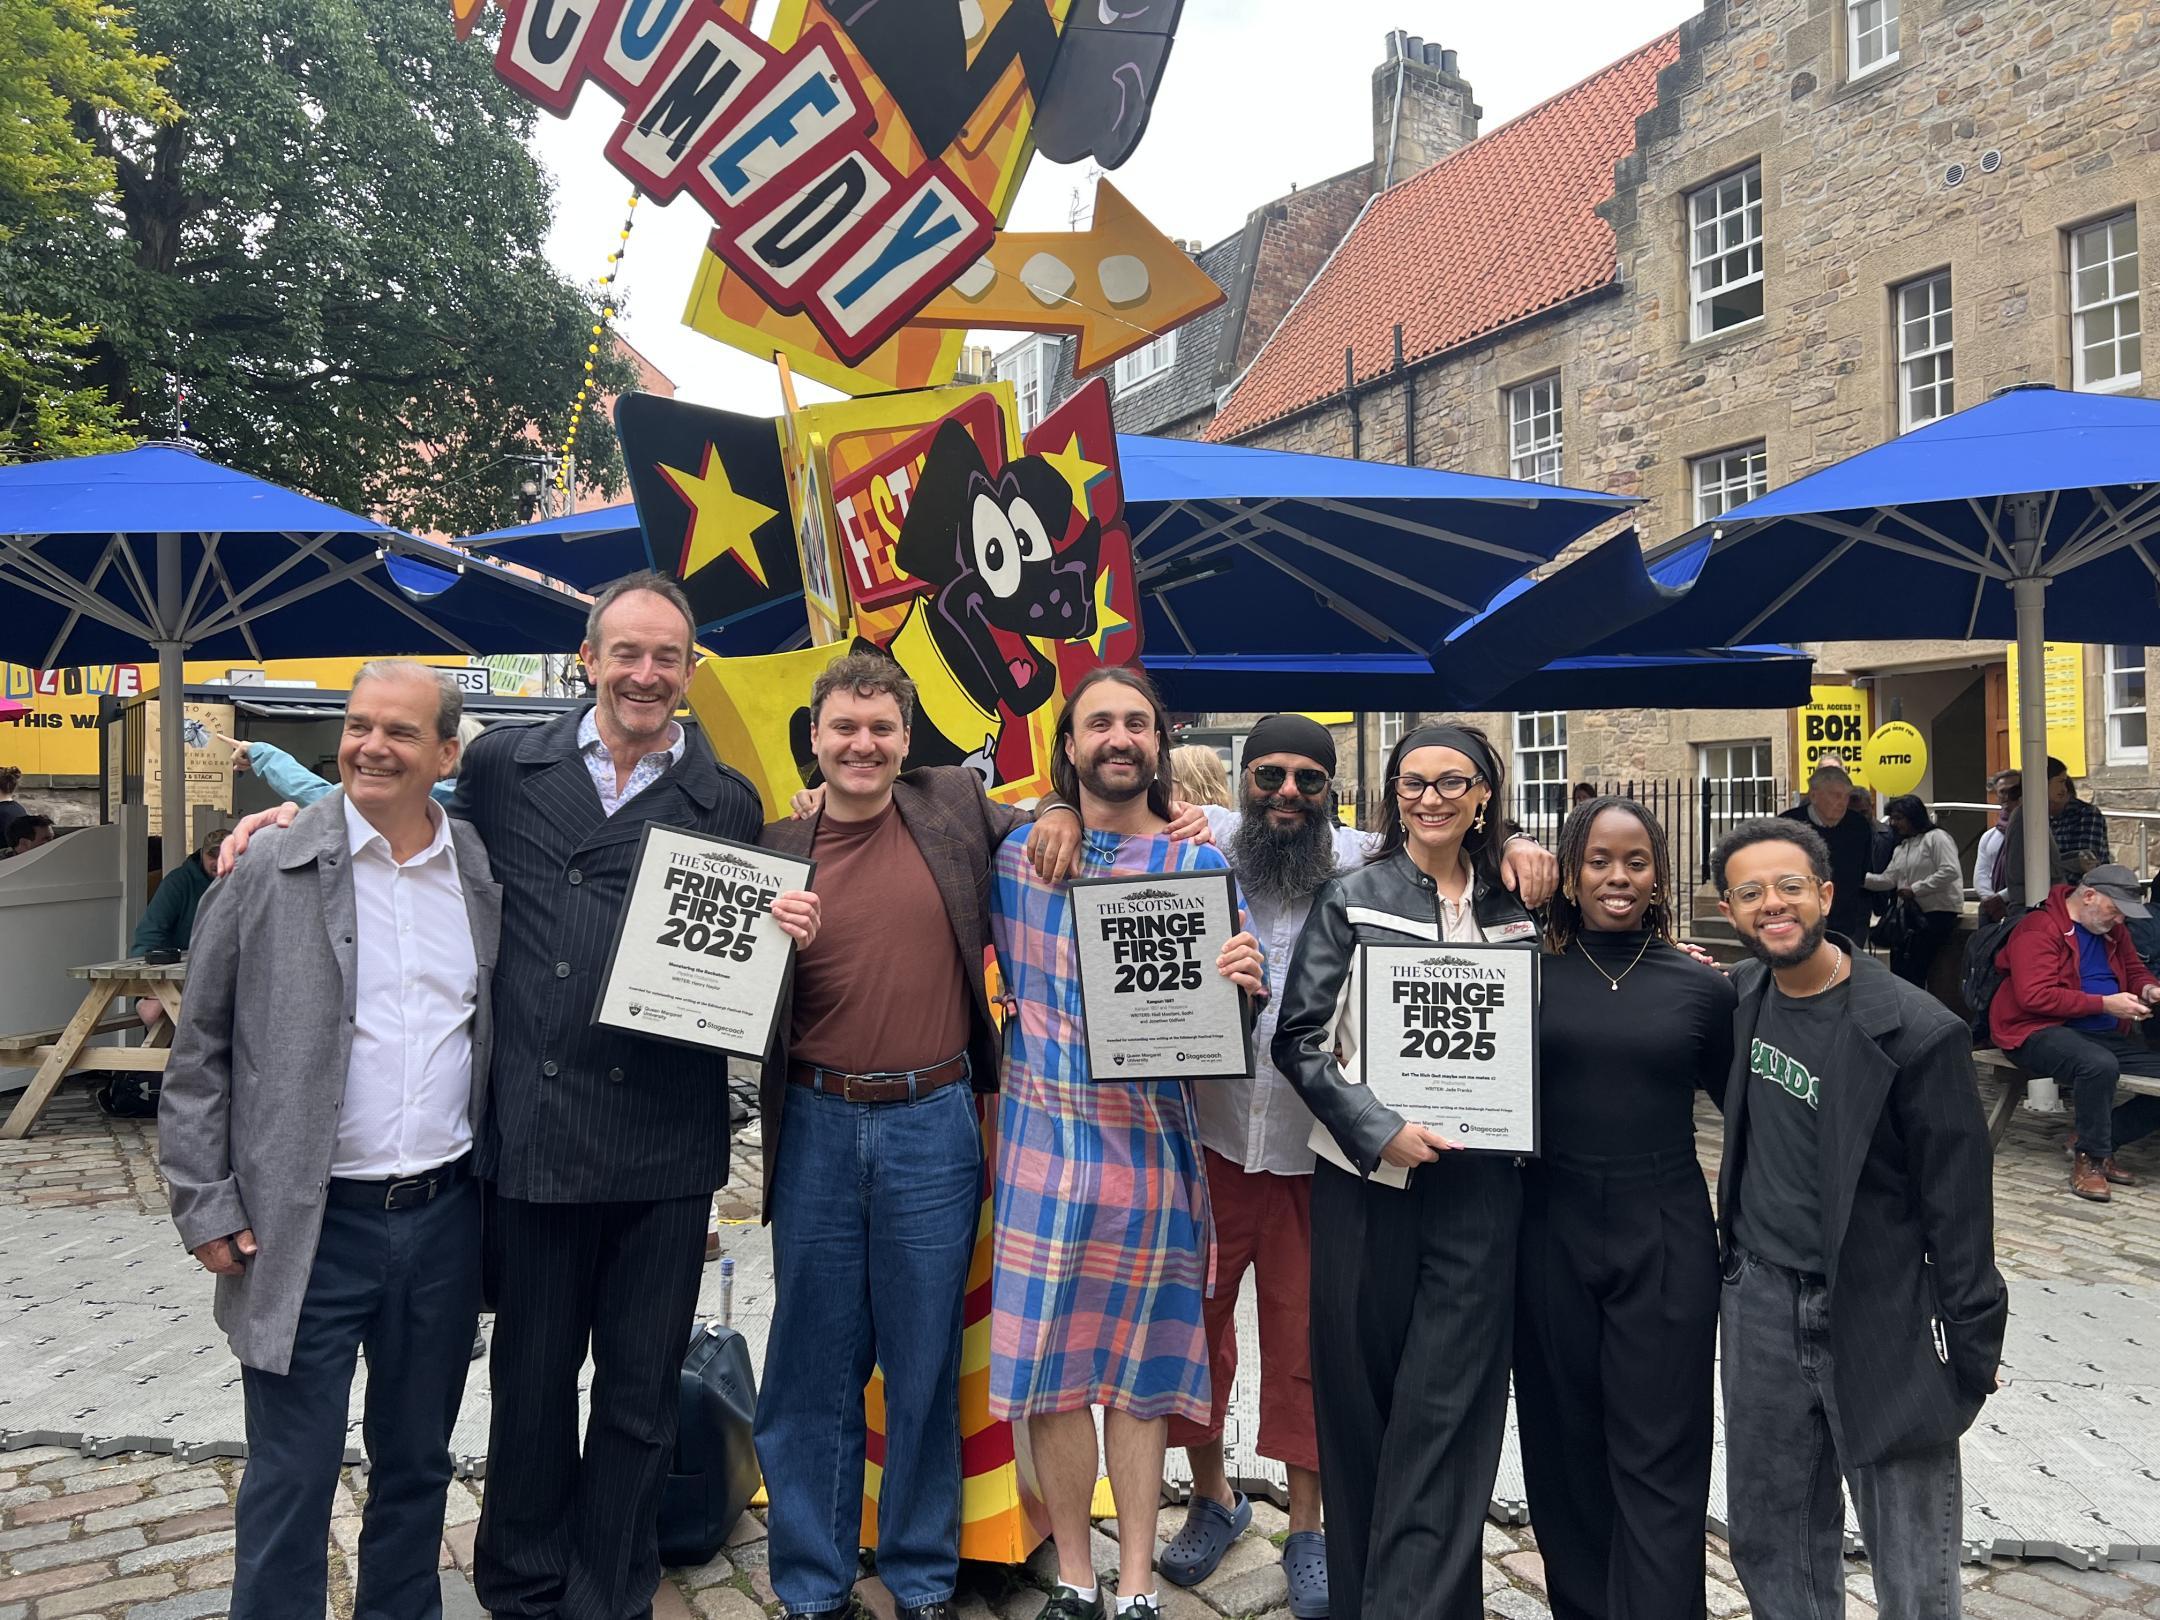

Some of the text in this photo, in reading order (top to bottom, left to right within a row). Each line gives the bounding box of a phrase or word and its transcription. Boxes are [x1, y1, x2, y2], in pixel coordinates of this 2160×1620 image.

[1806, 715, 1862, 741] BOX
[1807, 746, 1862, 761] OFFICE
[1879, 754, 1911, 764] ATTIC
[670, 852, 783, 888] THE SCOTSMAN
[664, 867, 777, 914] FRINGE
[669, 893, 761, 932] FIRST
[1097, 897, 1205, 915] THE SCOTSMAN
[1101, 912, 1206, 941] FRINGE
[656, 918, 757, 963] 2025
[1113, 937, 1197, 963] FIRST
[1114, 961, 1202, 994] 2025
[1390, 966, 1506, 980] THE SCOTSMAN
[1392, 980, 1505, 1006] FRINGE
[707, 1022, 744, 1035] Stagecoach
[1404, 1005, 1494, 1030] FIRST
[1400, 1030, 1496, 1061] 2025
